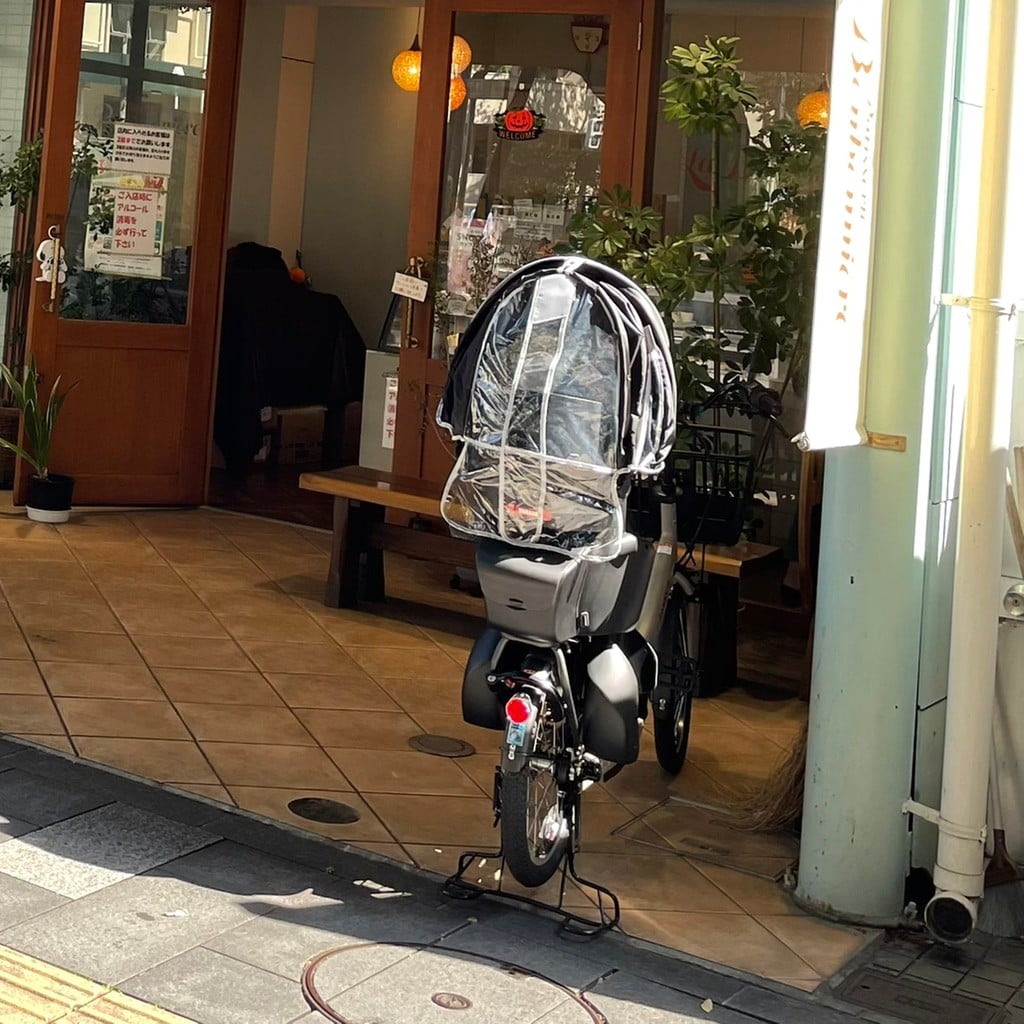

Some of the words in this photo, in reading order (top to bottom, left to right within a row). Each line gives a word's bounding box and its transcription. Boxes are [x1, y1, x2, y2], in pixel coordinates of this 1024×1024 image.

[118, 203, 149, 213] アルコール
[115, 227, 148, 237] 必ず行って
[114, 239, 135, 249] 下さい
